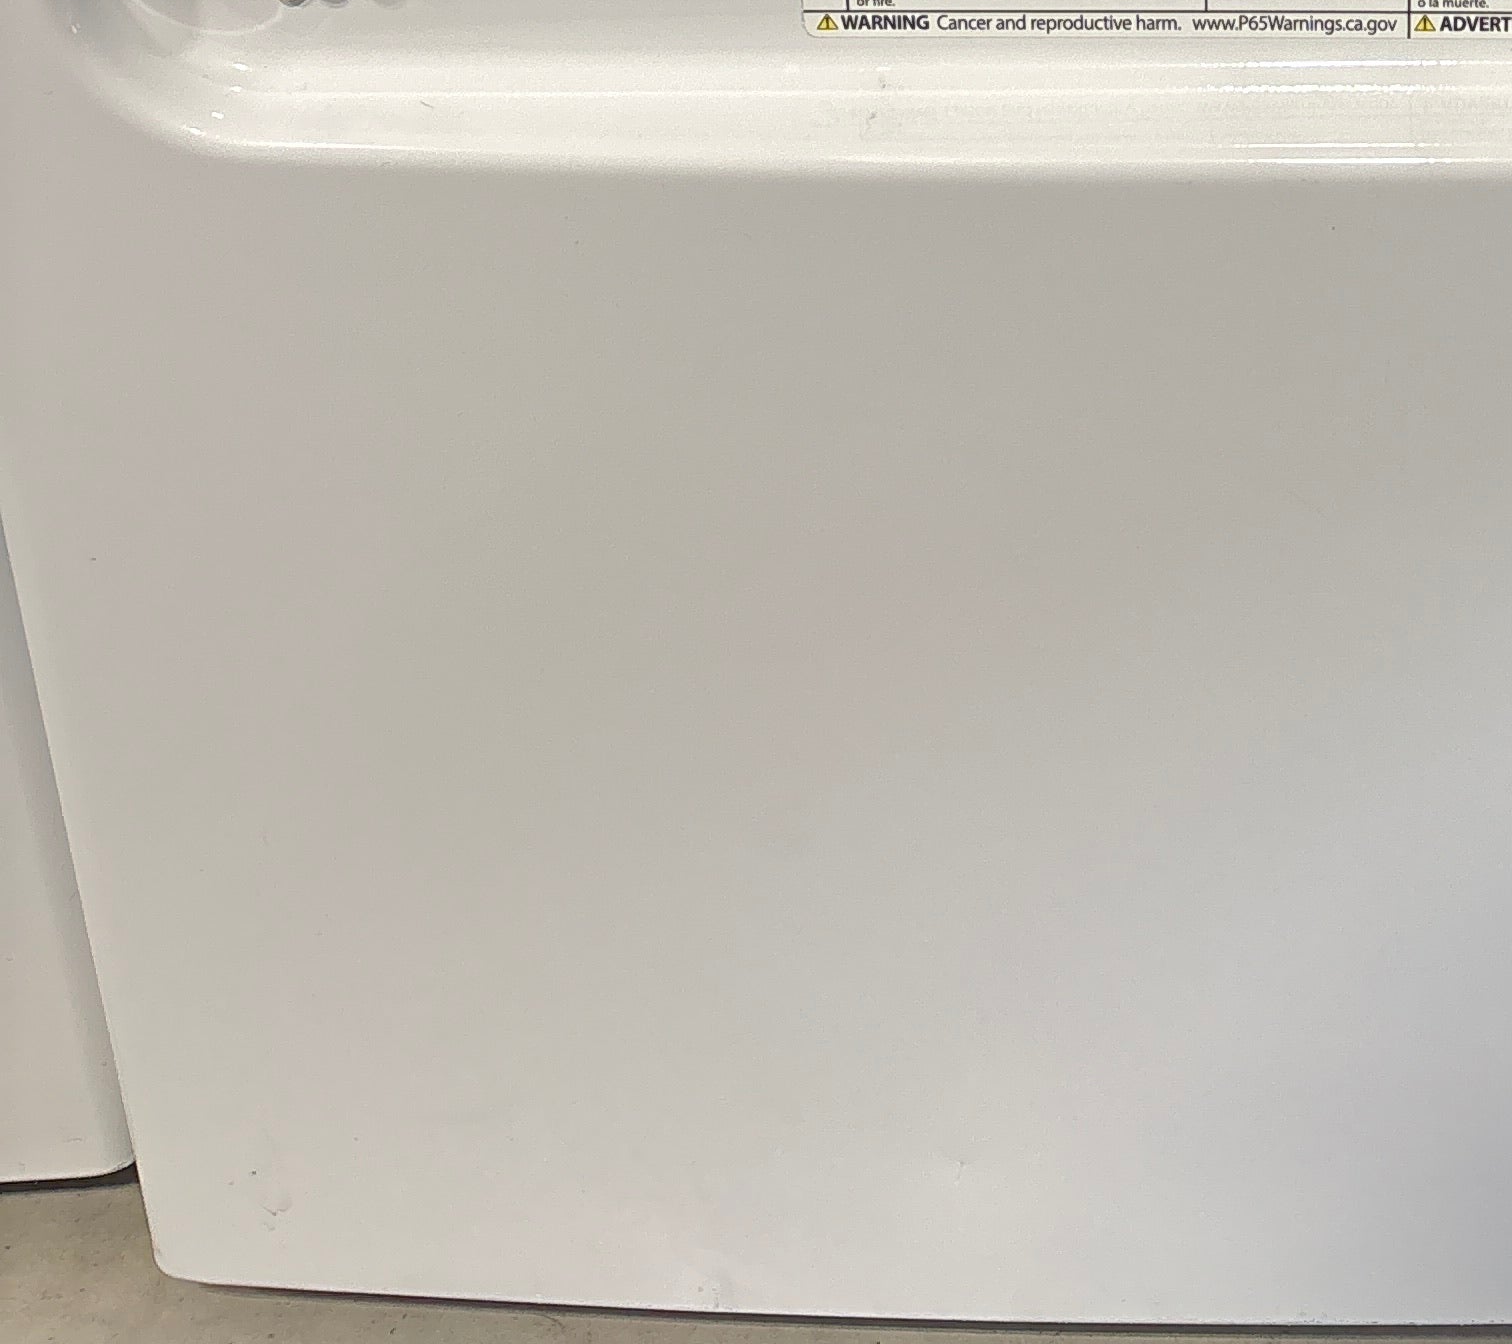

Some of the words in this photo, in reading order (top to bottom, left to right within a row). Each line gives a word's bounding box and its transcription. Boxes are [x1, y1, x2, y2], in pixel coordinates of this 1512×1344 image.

[840, 15, 929, 29] WARNING
[936, 15, 992, 30] Cancer
[995, 15, 1026, 30] and
[1030, 15, 1132, 33] reproductive
[1136, 15, 1181, 30] harm.
[1192, 16, 1397, 34] www.P65Warnings.ca.gov
